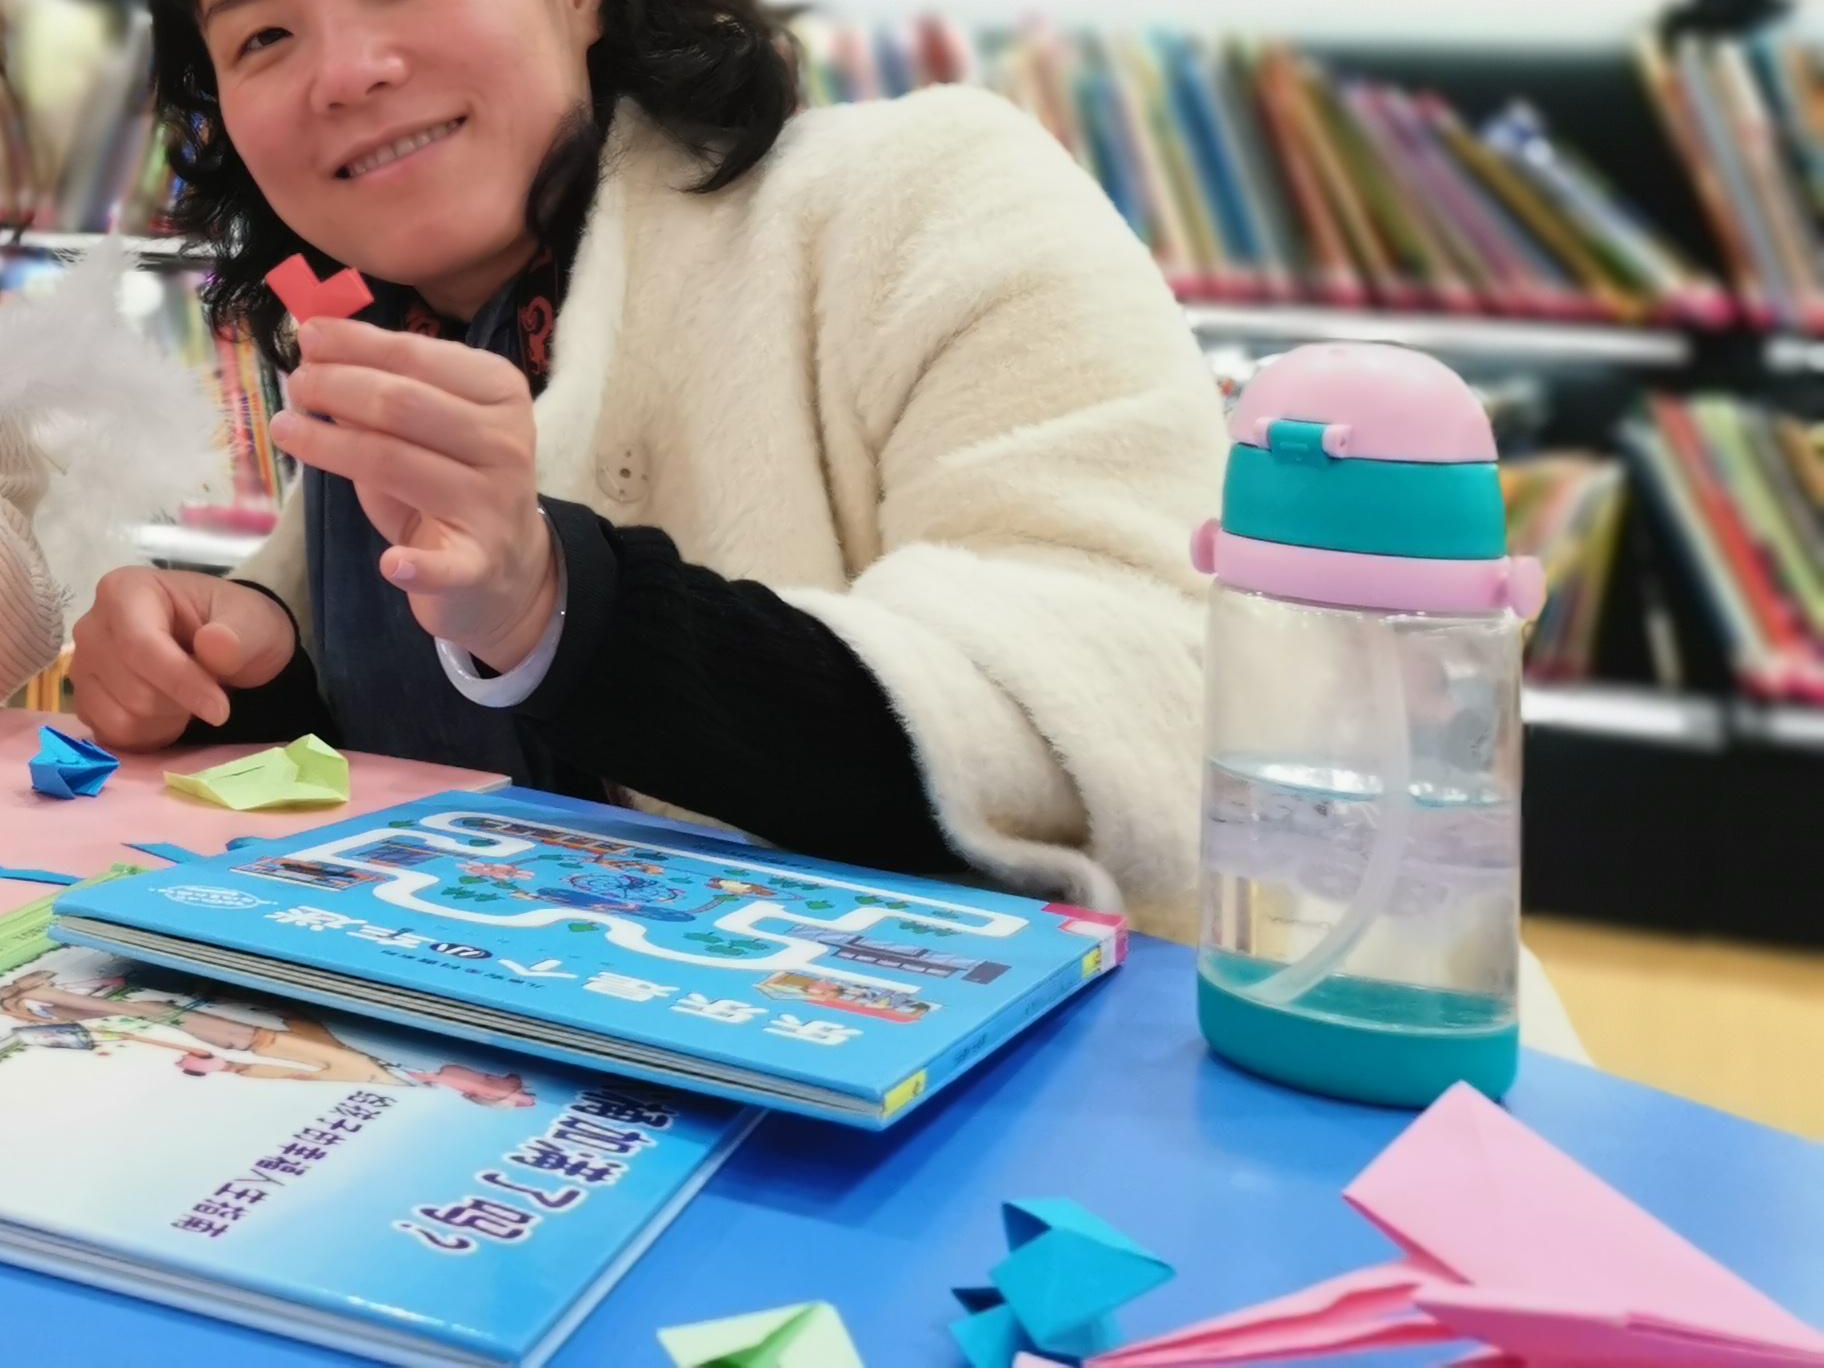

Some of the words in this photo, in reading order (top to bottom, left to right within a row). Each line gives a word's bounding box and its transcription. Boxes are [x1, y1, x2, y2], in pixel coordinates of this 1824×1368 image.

[264, 907, 862, 1046] 乐乐是个小车迷
[170, 1091, 398, 1239] 给孩子的幸福人生指南
